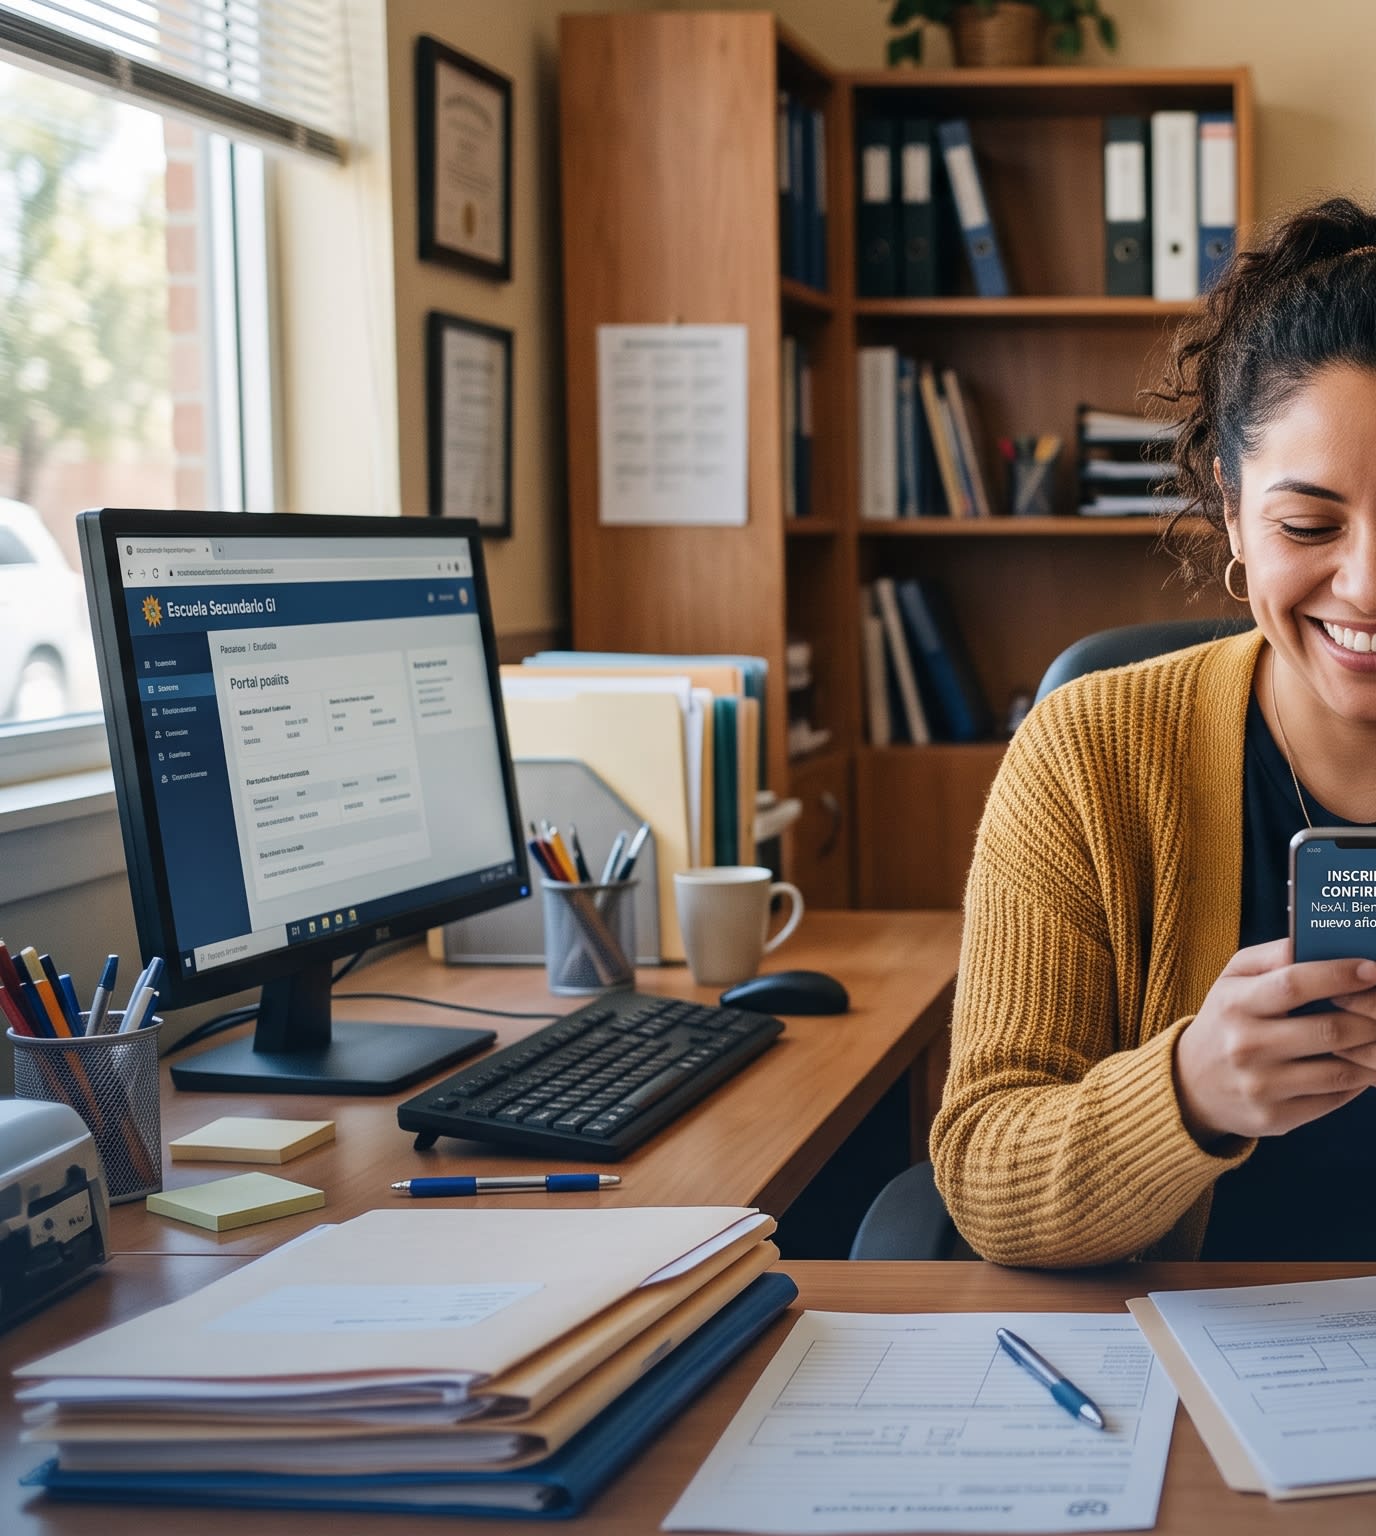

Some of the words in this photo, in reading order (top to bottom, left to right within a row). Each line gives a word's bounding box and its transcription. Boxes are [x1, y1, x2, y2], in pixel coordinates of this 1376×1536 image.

[167, 600, 208, 618] Escuela
[230, 675, 258, 690] Portal
[1311, 901, 1349, 913] NexAI.
